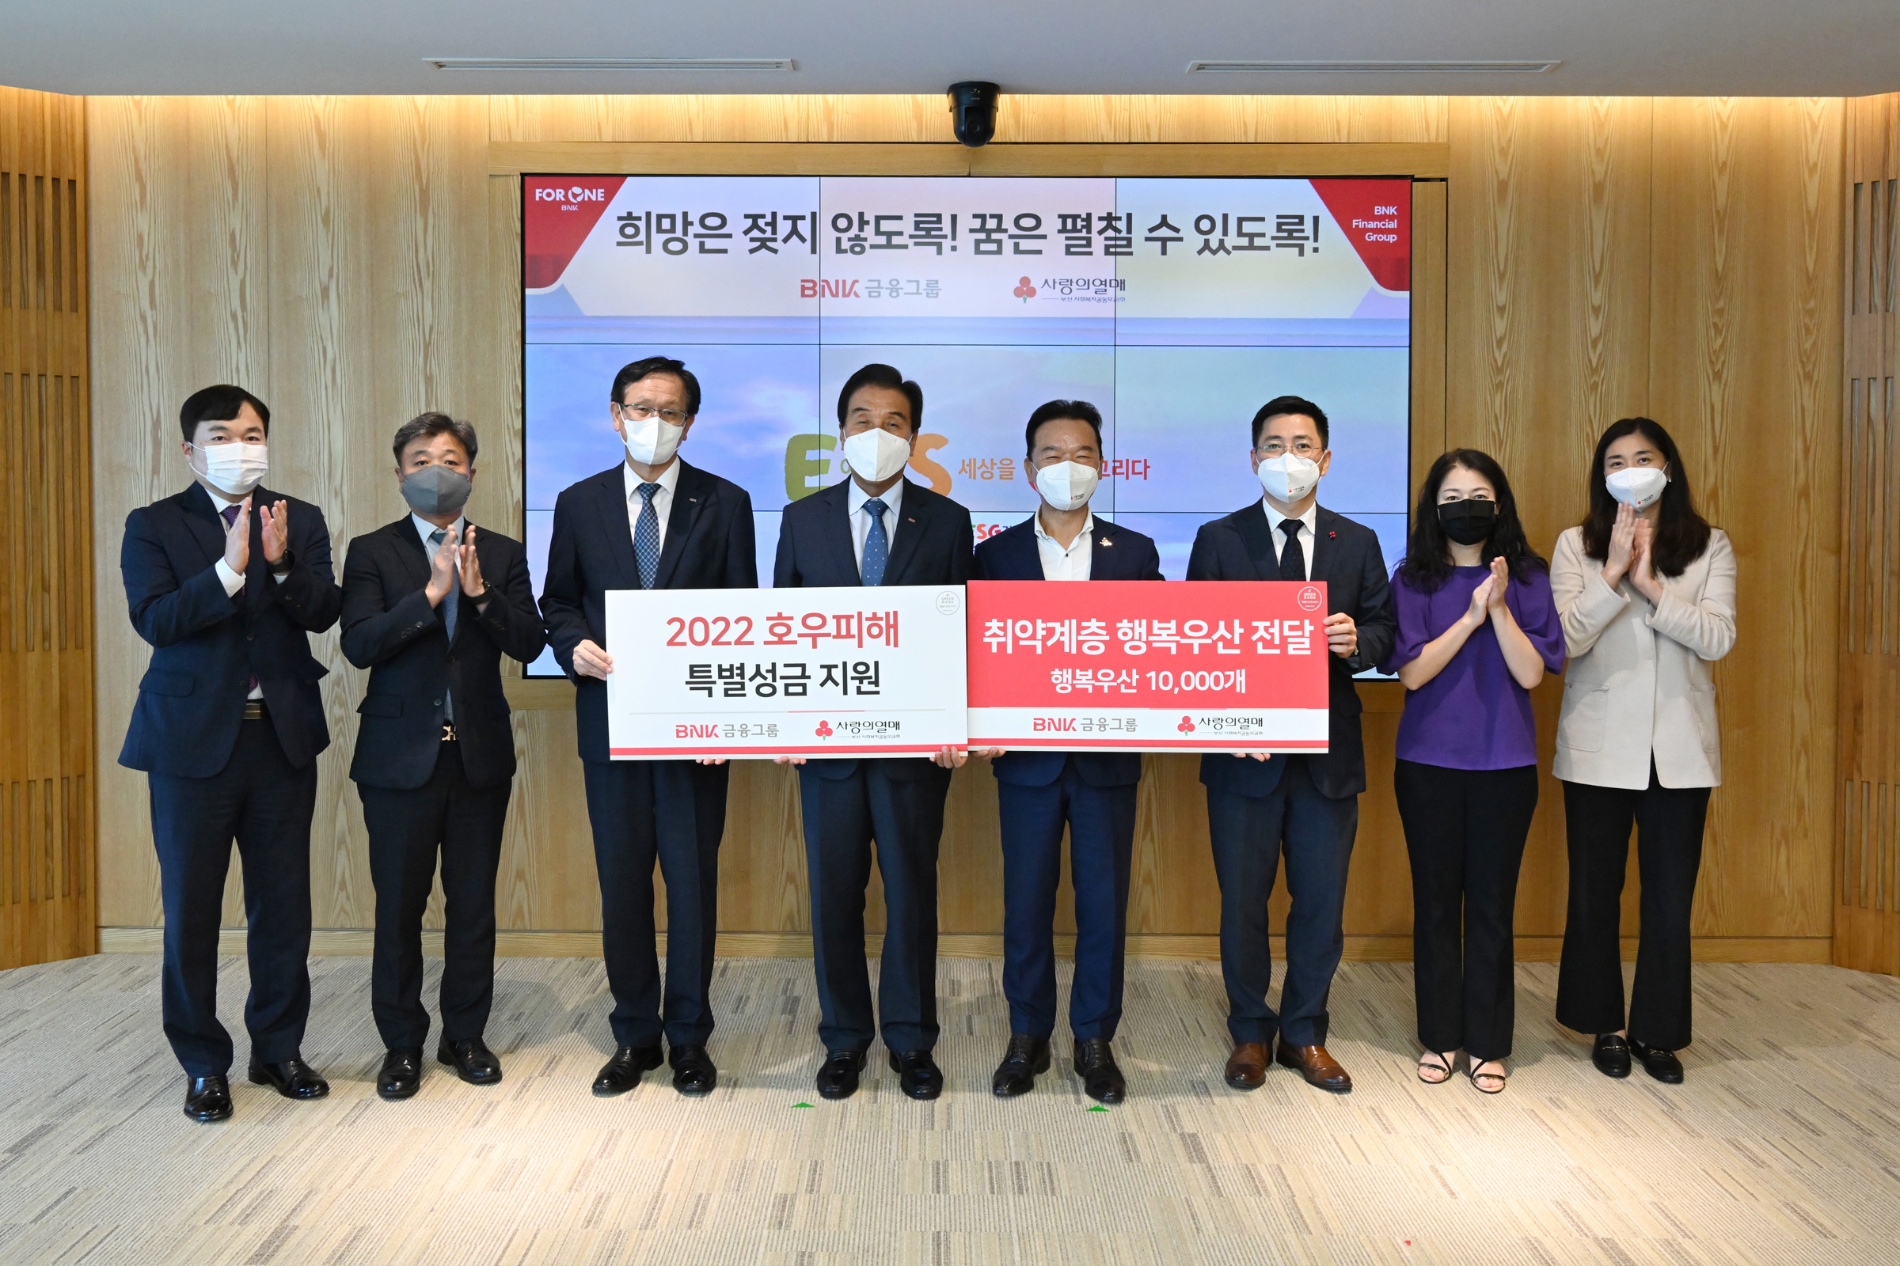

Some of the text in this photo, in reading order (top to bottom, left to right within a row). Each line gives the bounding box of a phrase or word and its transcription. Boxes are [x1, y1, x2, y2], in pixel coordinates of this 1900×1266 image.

[535, 188, 566, 202] FOR
[1375, 206, 1397, 215] BNK
[1353, 219, 1397, 228] Financial
[616, 211, 1319, 257] 희망은 젖지 않도록! 꿈은 펼칠 수 있도록!
[1365, 233, 1397, 243] Group
[800, 279, 941, 299] BNK 금융그룹
[1041, 278, 1126, 295] 사랑의열매
[958, 458, 1015, 480] 세상을
[972, 523, 1002, 540] SG
[667, 611, 898, 649] 2022 호우피해
[983, 618, 1314, 655] 취약계층 행복우산 전달
[685, 661, 880, 697] 특별성금 지원
[1051, 669, 1246, 694] 행복우산 10,000개
[676, 724, 779, 738] BNK 금융그룹
[836, 720, 901, 734] 사랑의열매
[1034, 718, 1138, 732] BNK 금융그룹
[1198, 717, 1263, 730] 사랑의열매
